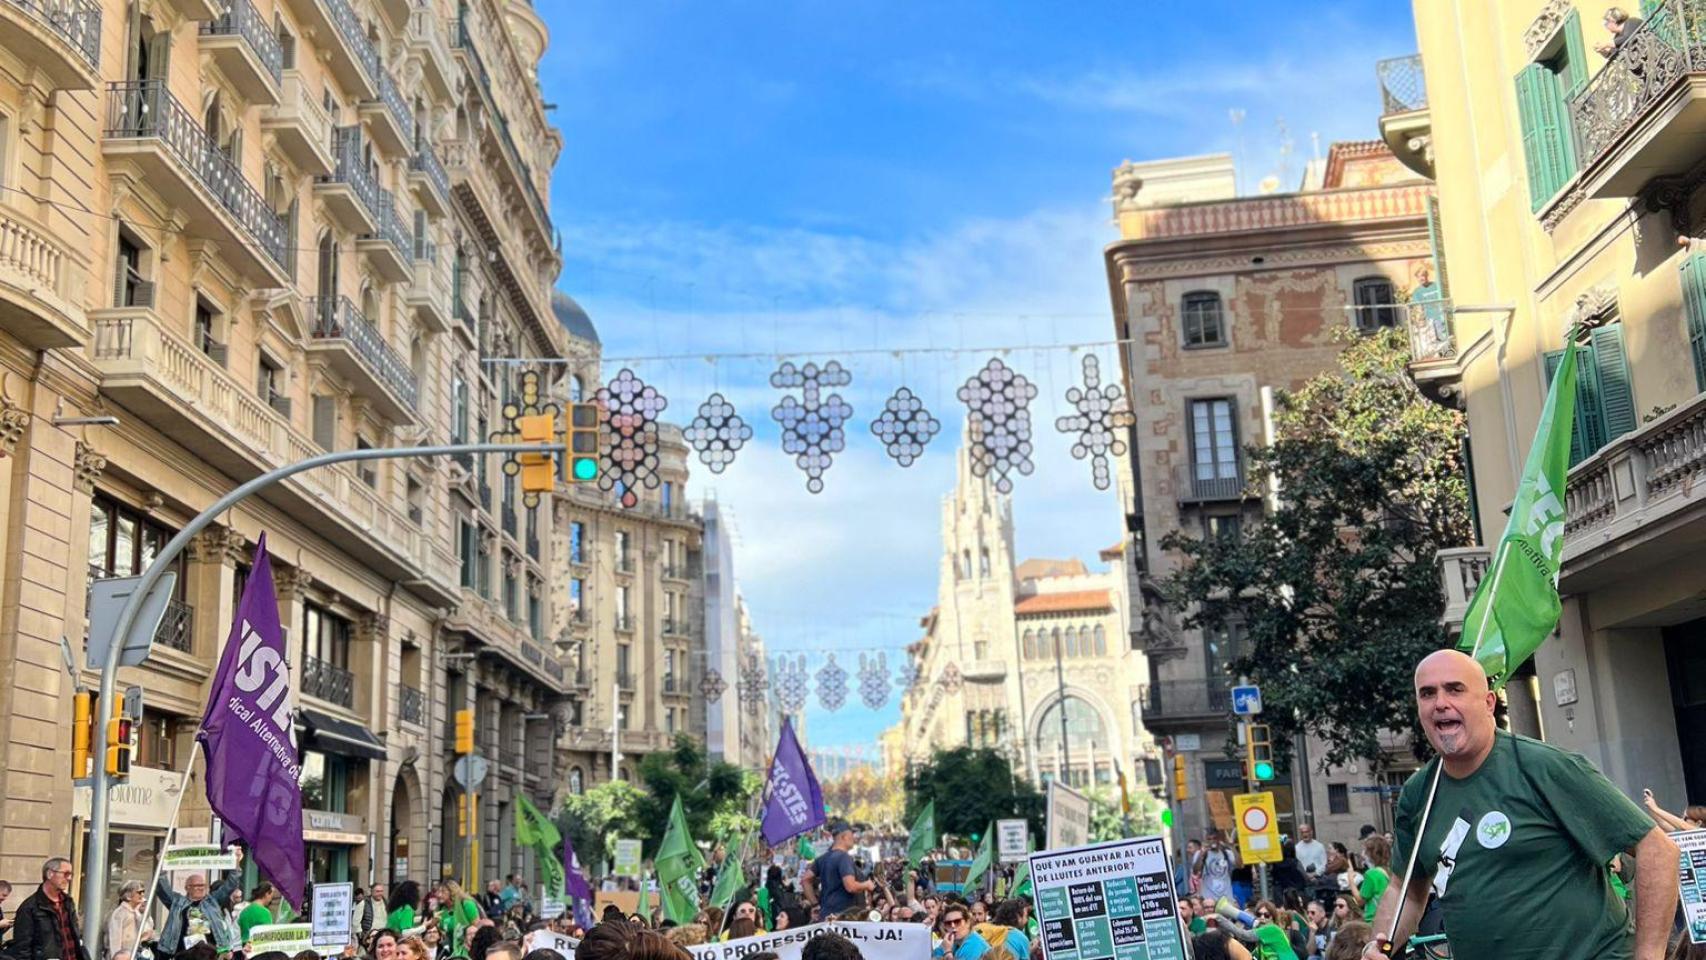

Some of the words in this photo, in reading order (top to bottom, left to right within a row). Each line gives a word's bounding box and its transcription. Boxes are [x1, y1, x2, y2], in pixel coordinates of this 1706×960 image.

[1055, 856, 1076, 867] VAM
[1078, 852, 1122, 865] GUANYAR
[1124, 849, 1135, 858] AL
[1137, 845, 1161, 856] CICLE
[1037, 873, 1049, 883] DE
[1050, 869, 1083, 881] LLUITES
[1085, 861, 1135, 877] ANTERIOR?
[723, 927, 868, 960] PROFESSIONAL,
[874, 928, 903, 941] JA!
